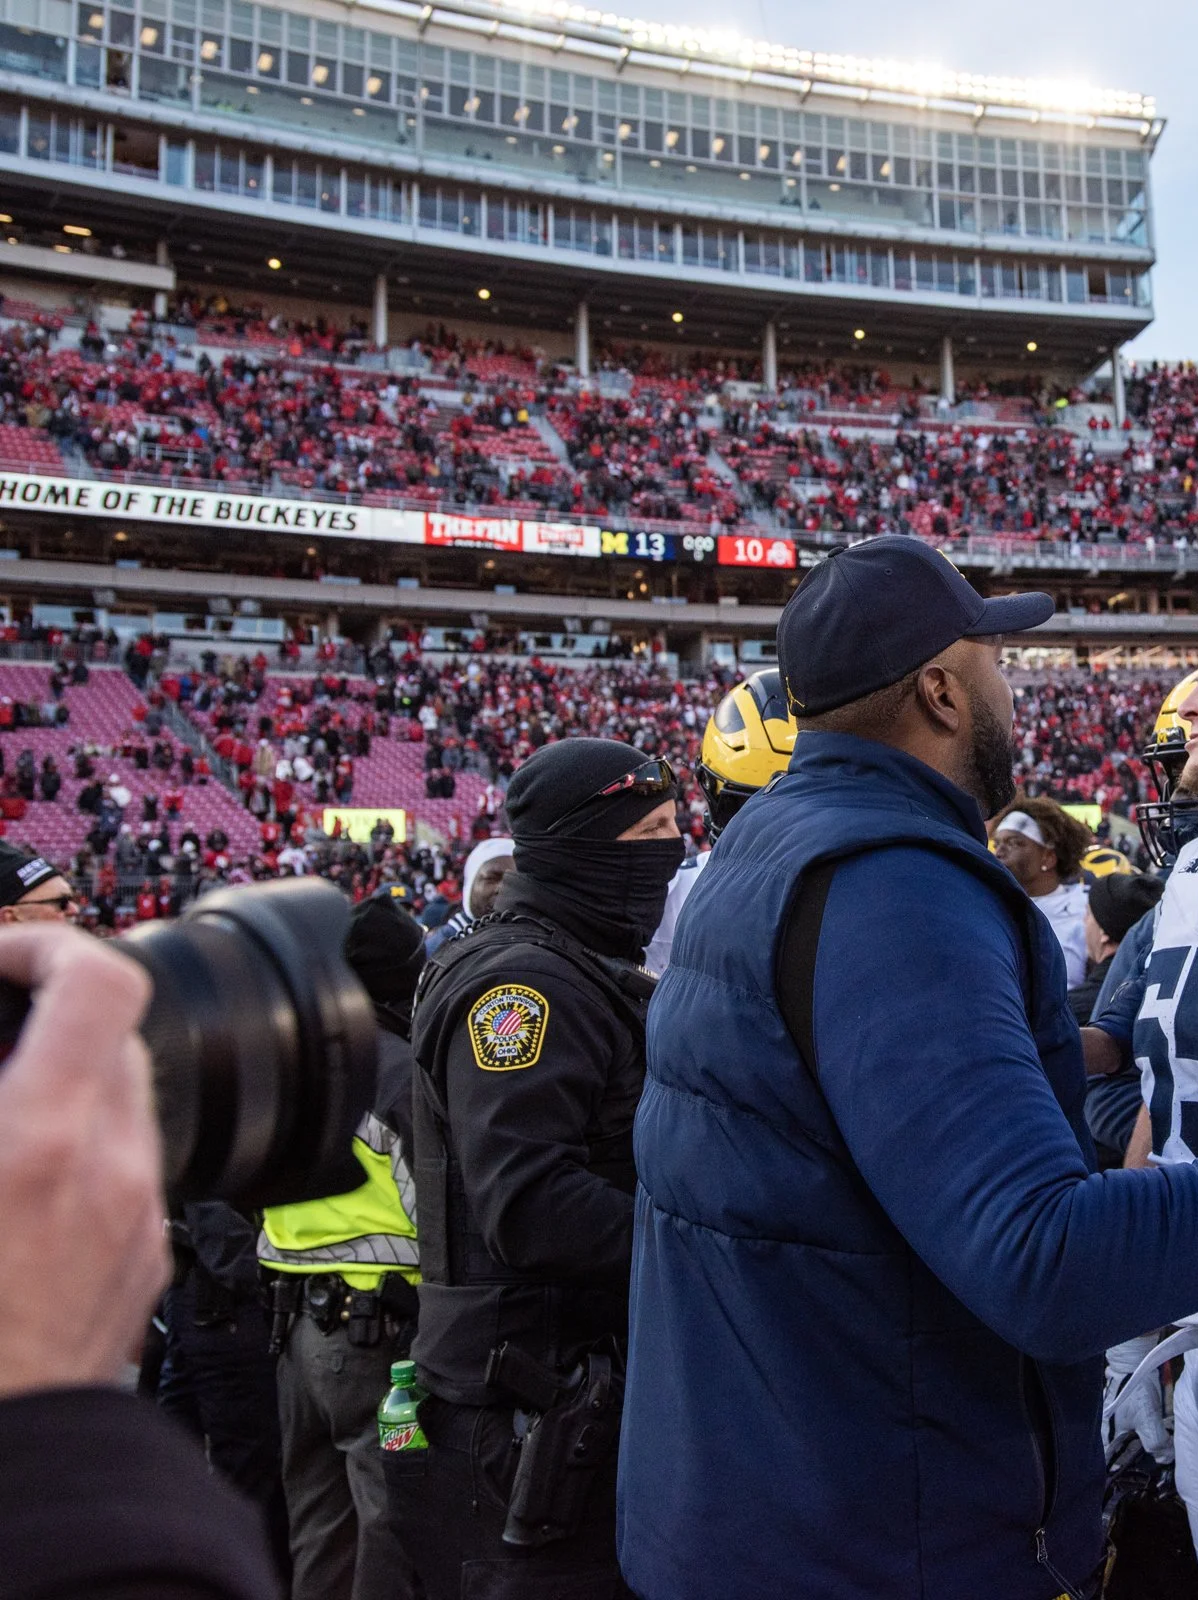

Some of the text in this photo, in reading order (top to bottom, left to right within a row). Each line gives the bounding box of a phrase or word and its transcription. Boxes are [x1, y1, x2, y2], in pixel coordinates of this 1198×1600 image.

[0, 479, 358, 532] HOME OF THE BUCKEYES
[635, 532, 665, 556] 13
[735, 539, 763, 562] 10
[480, 995, 537, 1015] CLINTON TOWNSHIP
[493, 1033, 520, 1042] POLICE
[497, 1047, 517, 1055] OHIO
